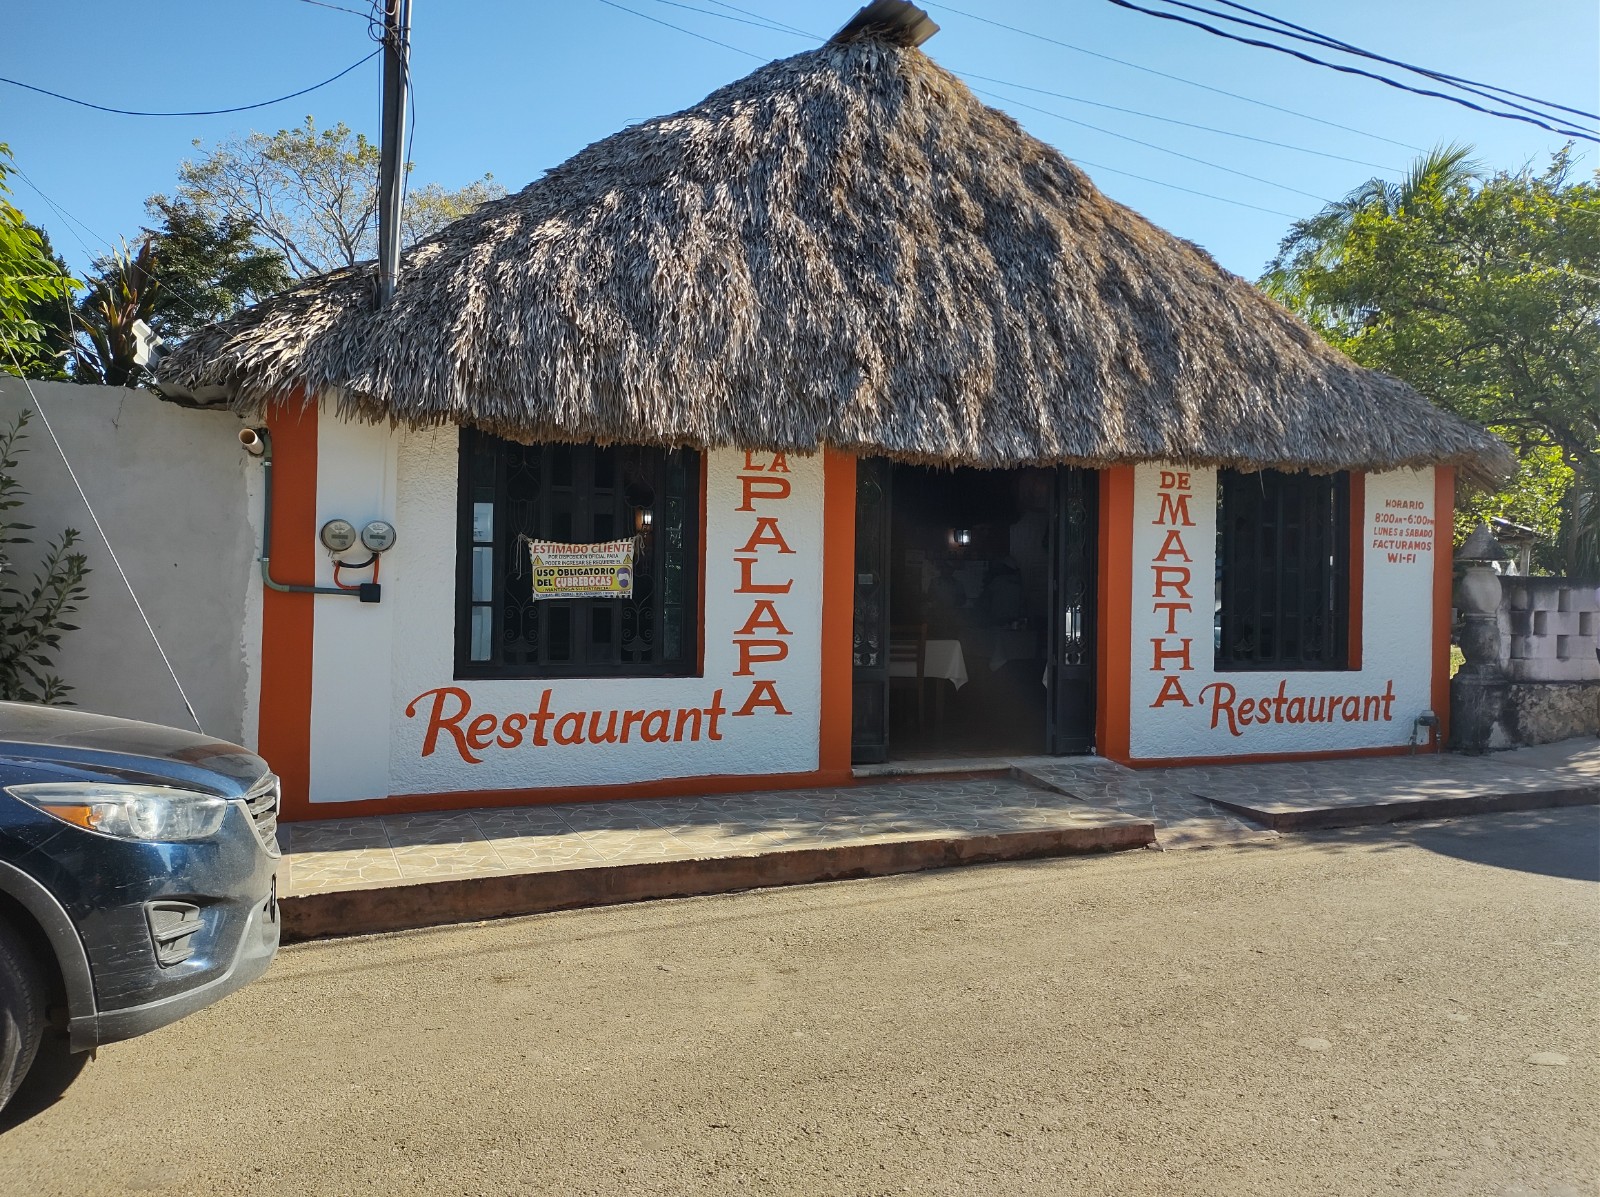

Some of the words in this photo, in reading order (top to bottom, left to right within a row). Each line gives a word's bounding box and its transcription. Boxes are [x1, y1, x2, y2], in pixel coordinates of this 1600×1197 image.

[743, 447, 791, 473] LA
[1160, 471, 1191, 490] DE
[1385, 499, 1425, 510] HORARIO
[1373, 527, 1398, 536] LUNES
[1405, 528, 1433, 538] SABADO
[533, 544, 588, 554] ESTIMADO
[591, 544, 632, 554] CLIENTE
[1372, 540, 1432, 551] FACTURAMOS
[1387, 553, 1417, 563] WI-FI
[536, 569, 555, 577] USO
[556, 567, 616, 577] OBLIGATORIO
[555, 576, 612, 588] CUBREBOCAS
[733, 476, 796, 716] PALAPA
[1149, 493, 1196, 708] MARTHA
[1198, 679, 1396, 737] Restaurant
[405, 686, 726, 765] Restaurant
